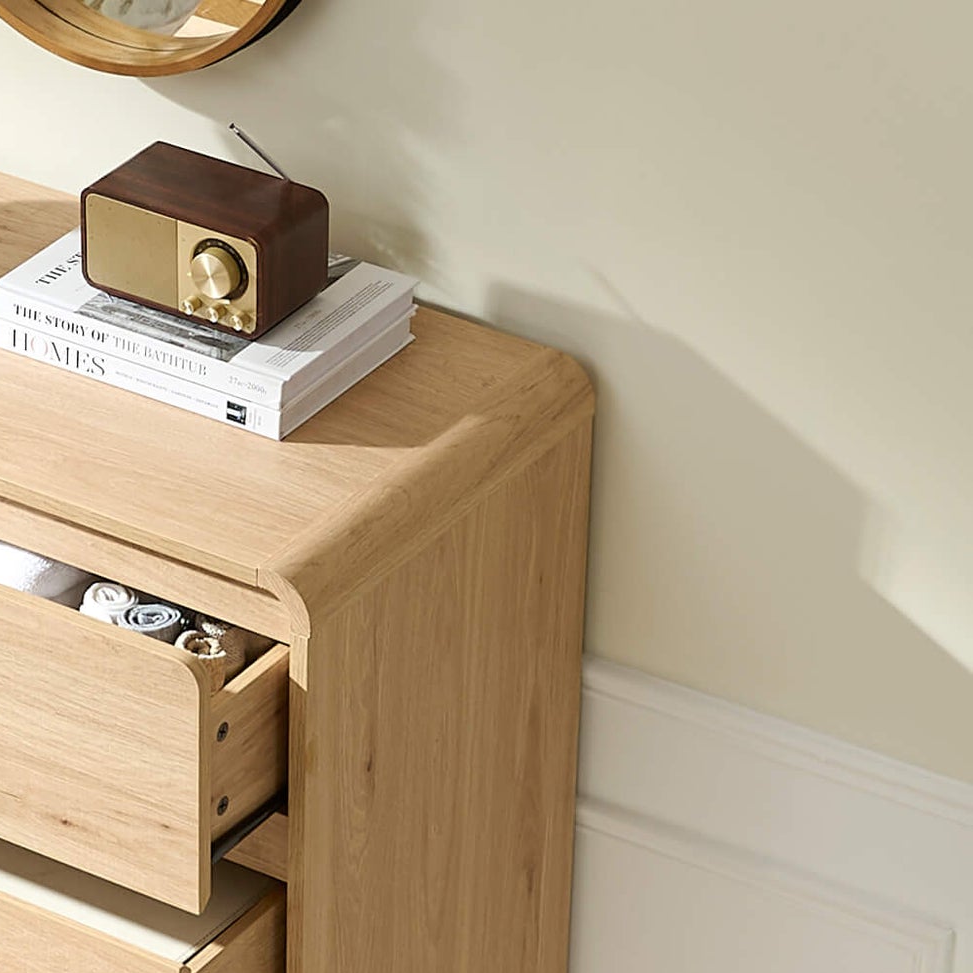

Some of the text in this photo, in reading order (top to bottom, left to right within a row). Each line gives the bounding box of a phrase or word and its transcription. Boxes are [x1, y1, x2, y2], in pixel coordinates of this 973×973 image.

[35, 264, 71, 284] THE
[12, 329, 105, 375] HOMES
[13, 303, 207, 376] THE STORY OF THE BATHTUB
